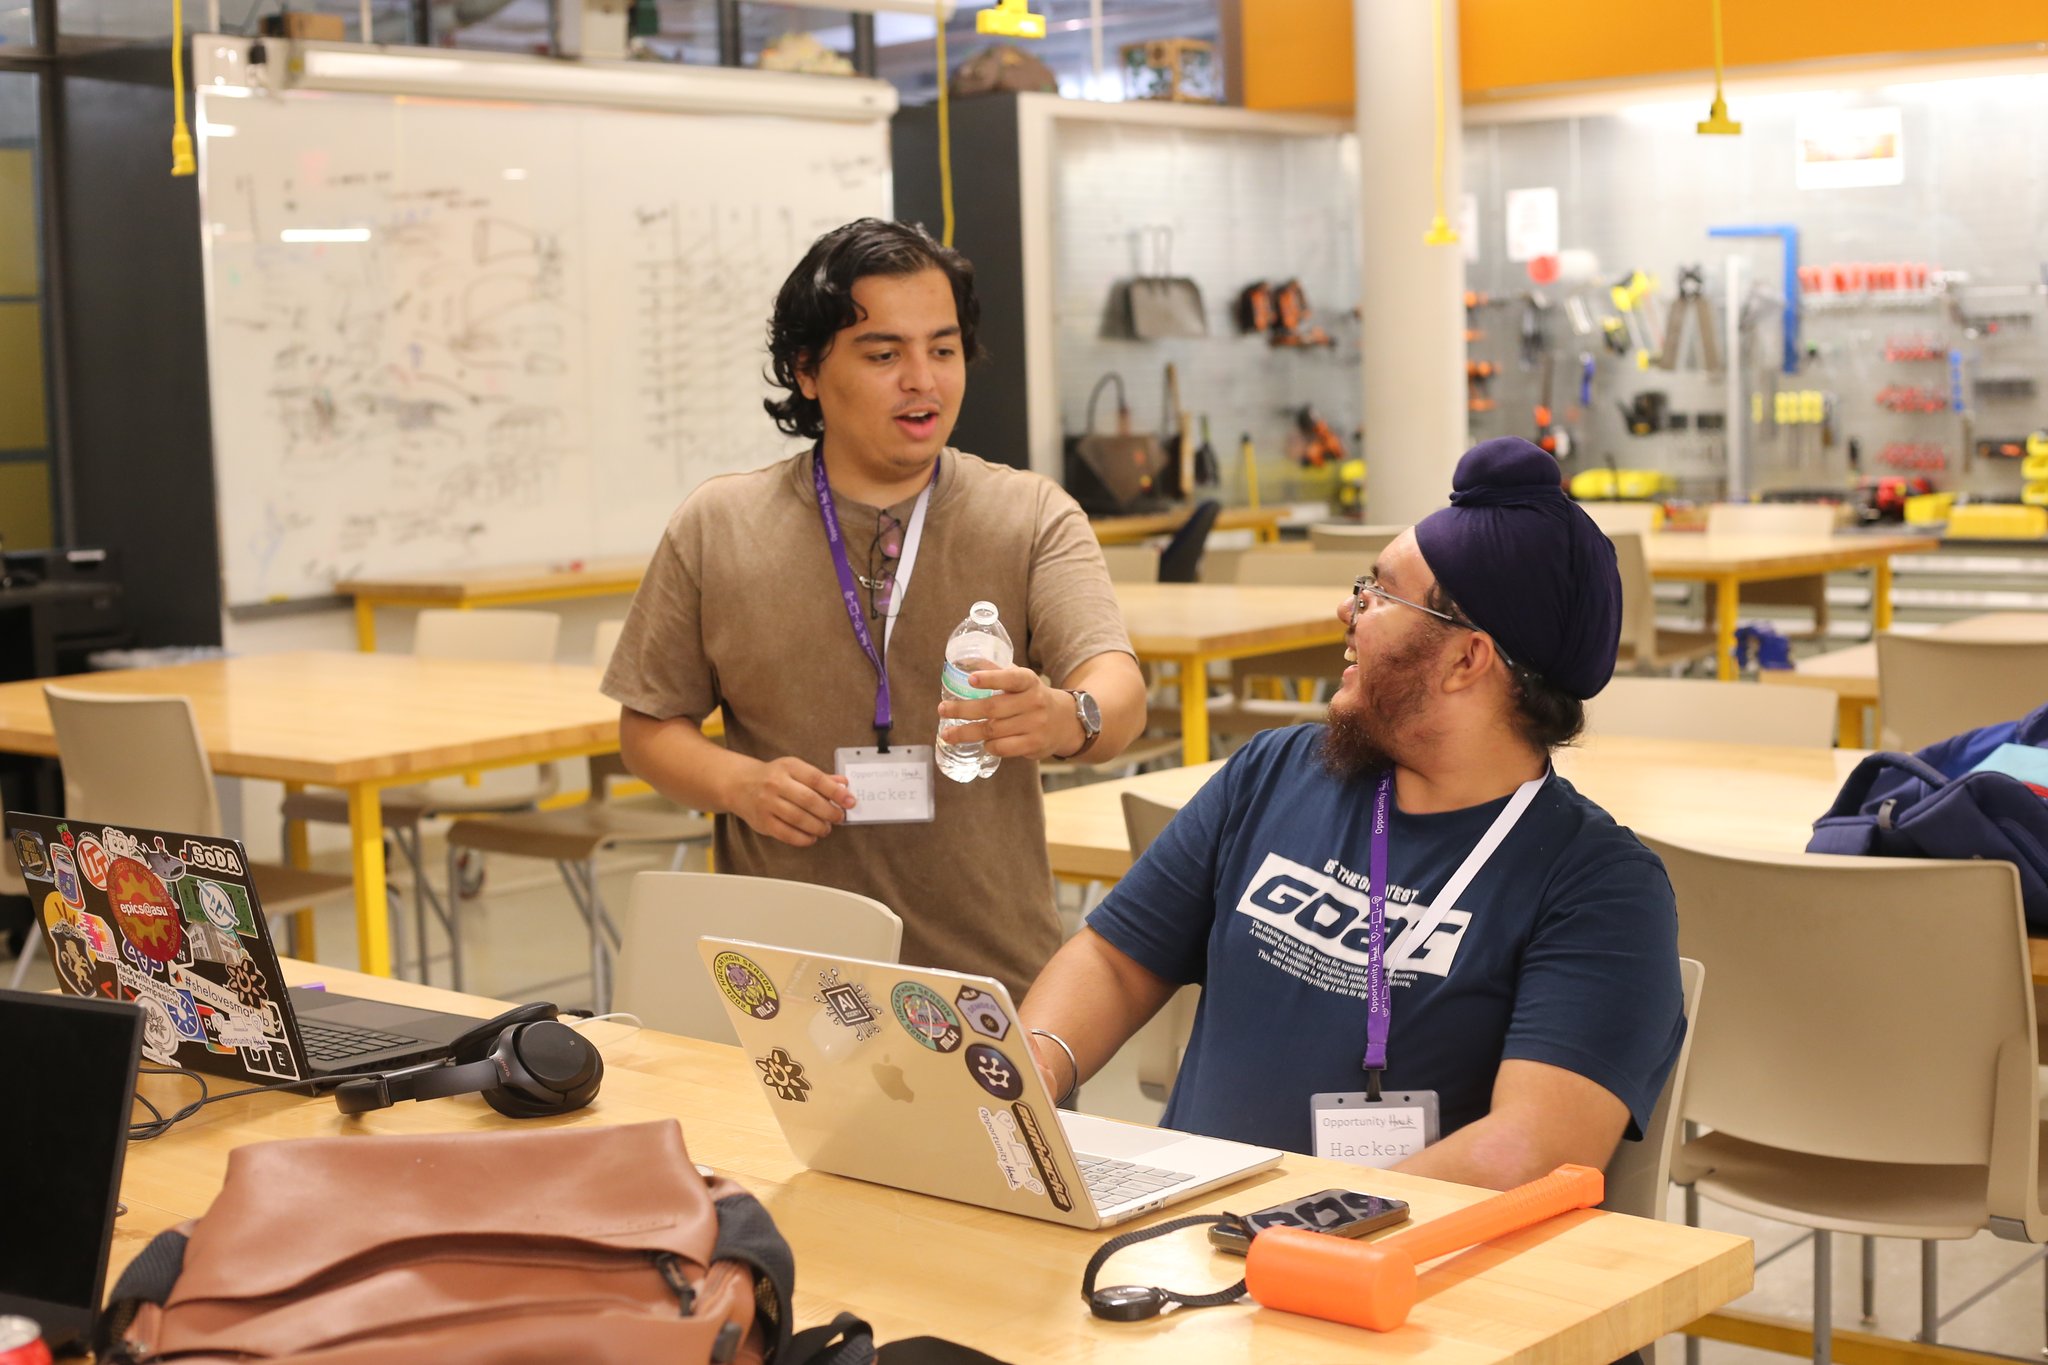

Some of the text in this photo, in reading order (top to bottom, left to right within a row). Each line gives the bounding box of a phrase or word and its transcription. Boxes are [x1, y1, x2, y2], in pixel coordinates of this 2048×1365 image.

[1375, 792, 1387, 834] Opportunity
[1337, 865, 1359, 888] THE
[120, 901, 168, 917] epics@asu
[117, 962, 134, 976] Hack
[133, 972, 151, 985] with
[119, 973, 138, 990] spark
[716, 955, 741, 986] HACKATHON
[743, 959, 772, 992] SEASON
[1370, 963, 1379, 1013] Opportunity
[756, 1001, 776, 1017] MLH
[837, 992, 857, 1012] AI
[918, 987, 952, 1017] SEASON
[940, 1029, 960, 1050] MLH
[276, 1051, 286, 1067] E
[1323, 1116, 1386, 1129] Opportunity
[981, 1109, 1007, 1162] Opportunity
[1330, 1141, 1410, 1157] Hacker
